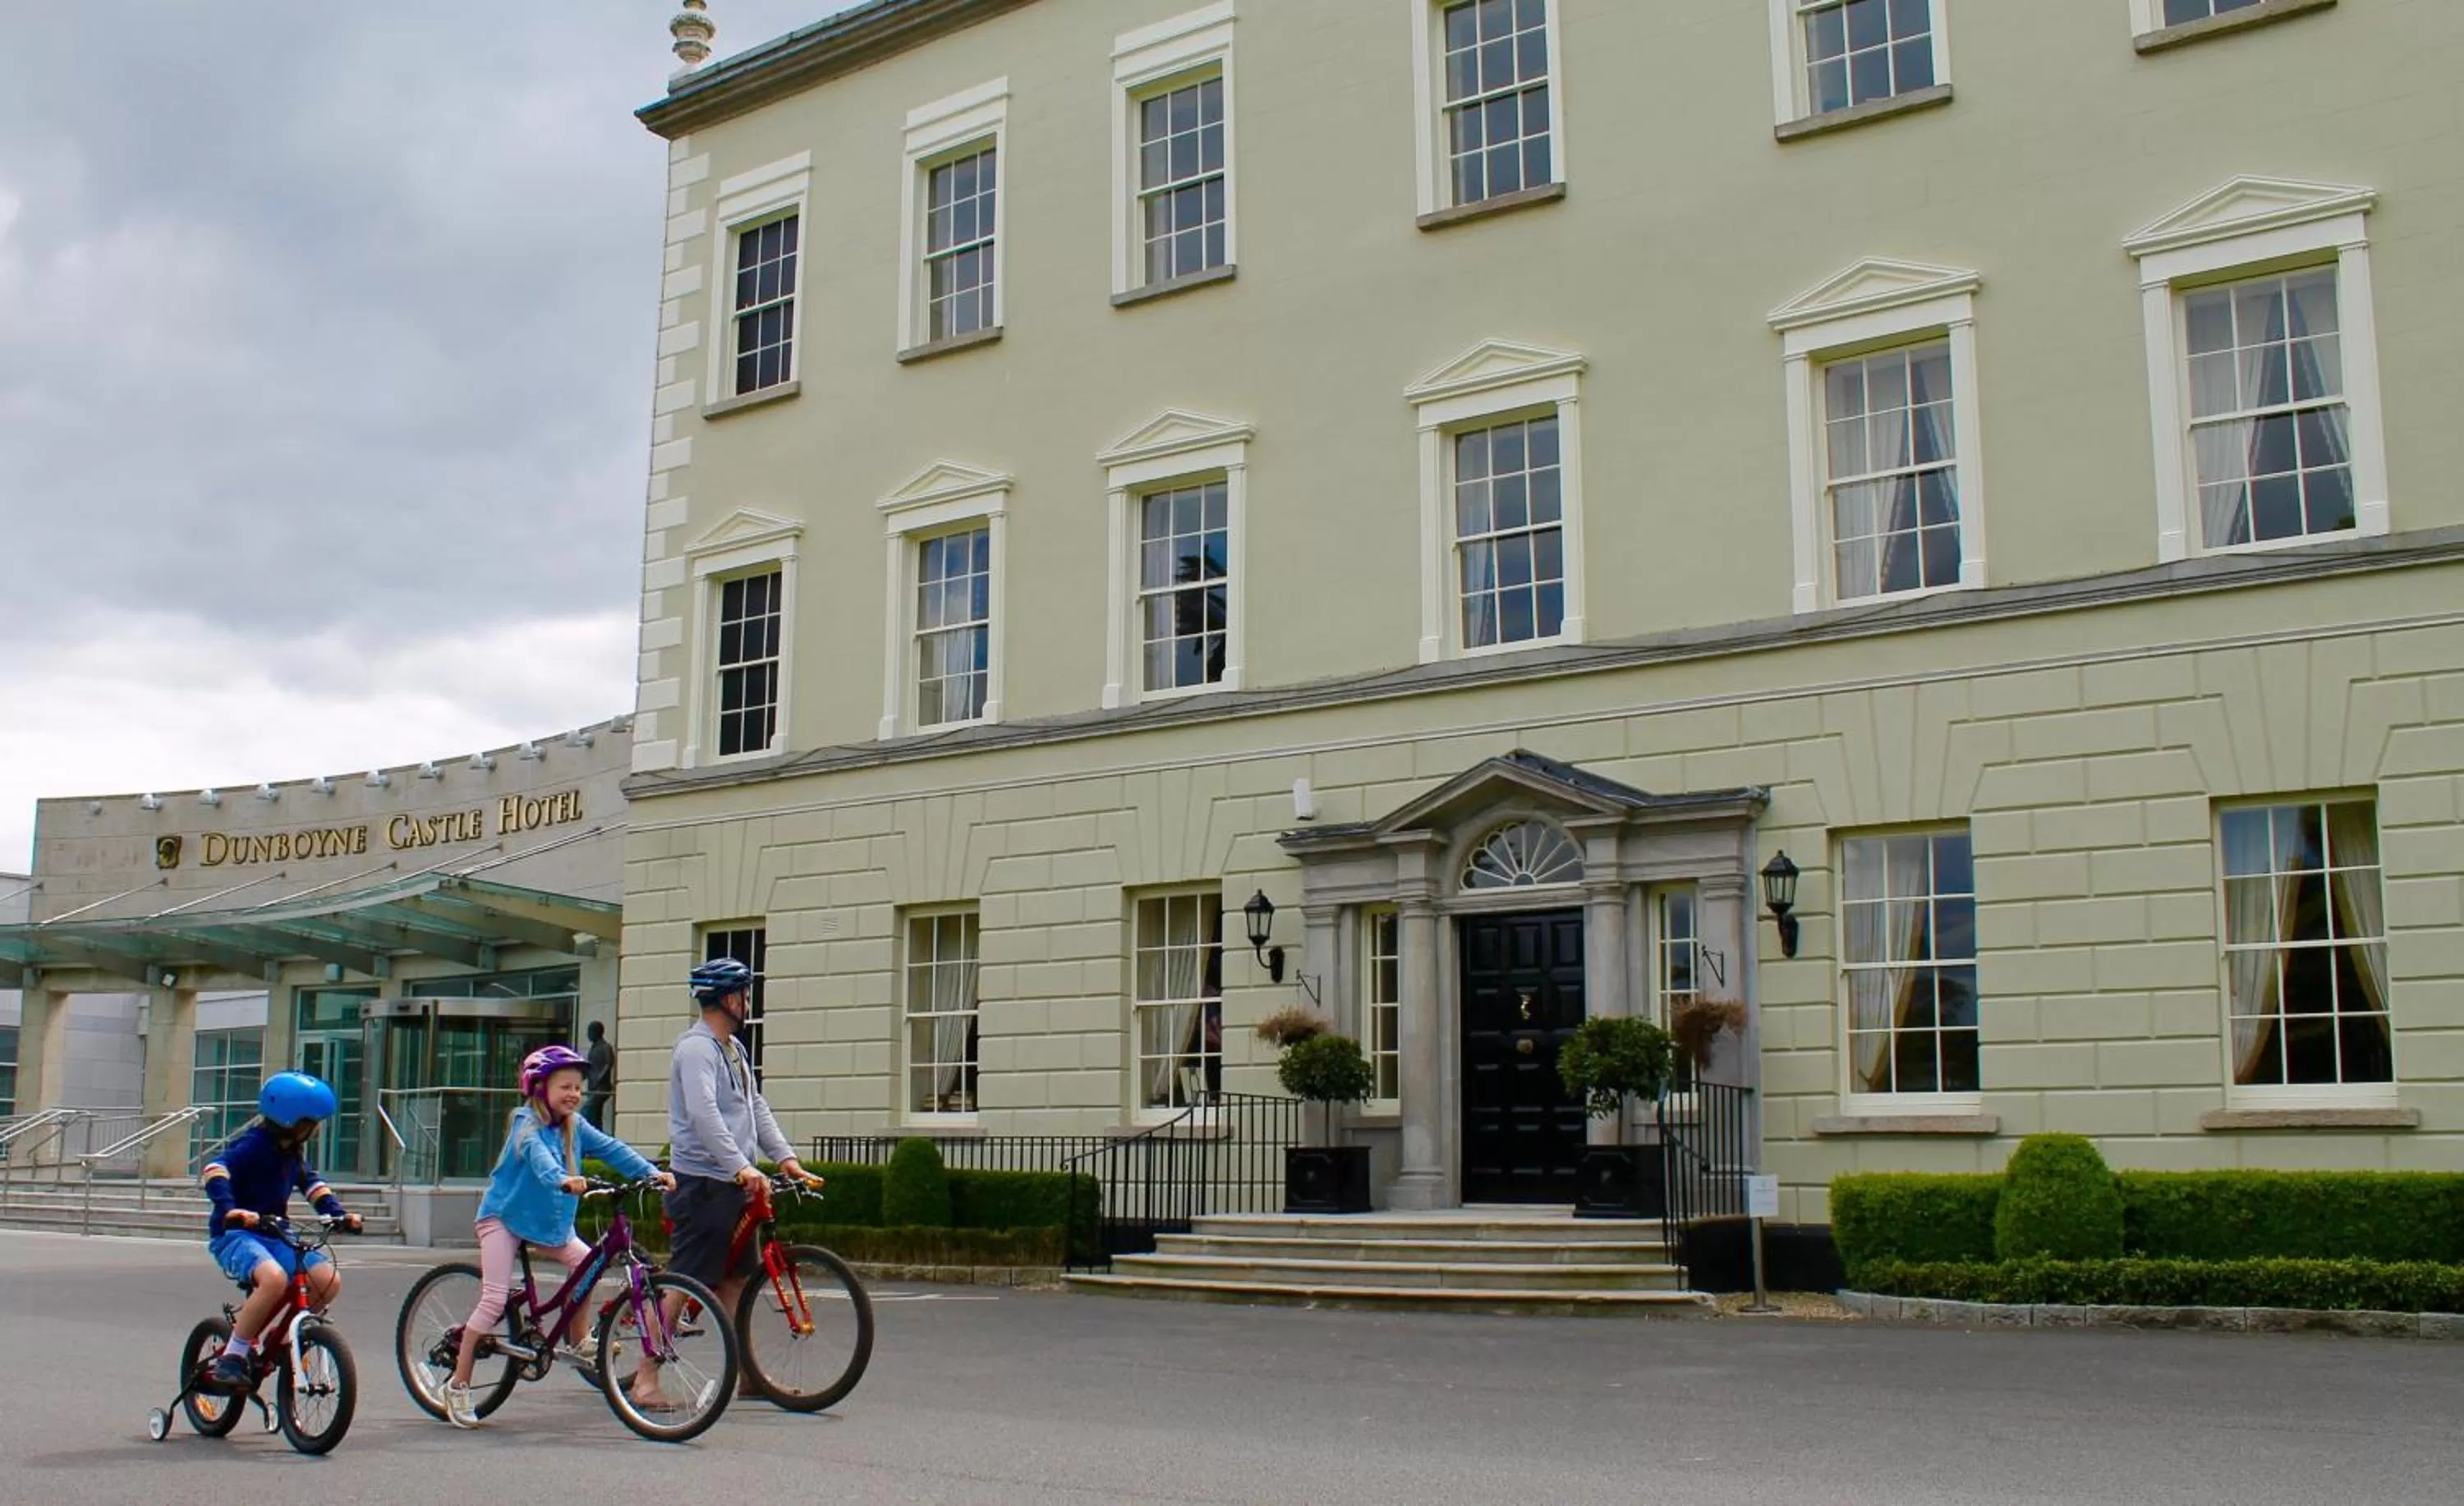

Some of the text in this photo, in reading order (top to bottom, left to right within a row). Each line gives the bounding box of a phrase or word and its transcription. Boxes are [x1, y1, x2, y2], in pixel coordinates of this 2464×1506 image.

[200, 790, 582, 866] DUNBOYNE CASTLE HOTEL
